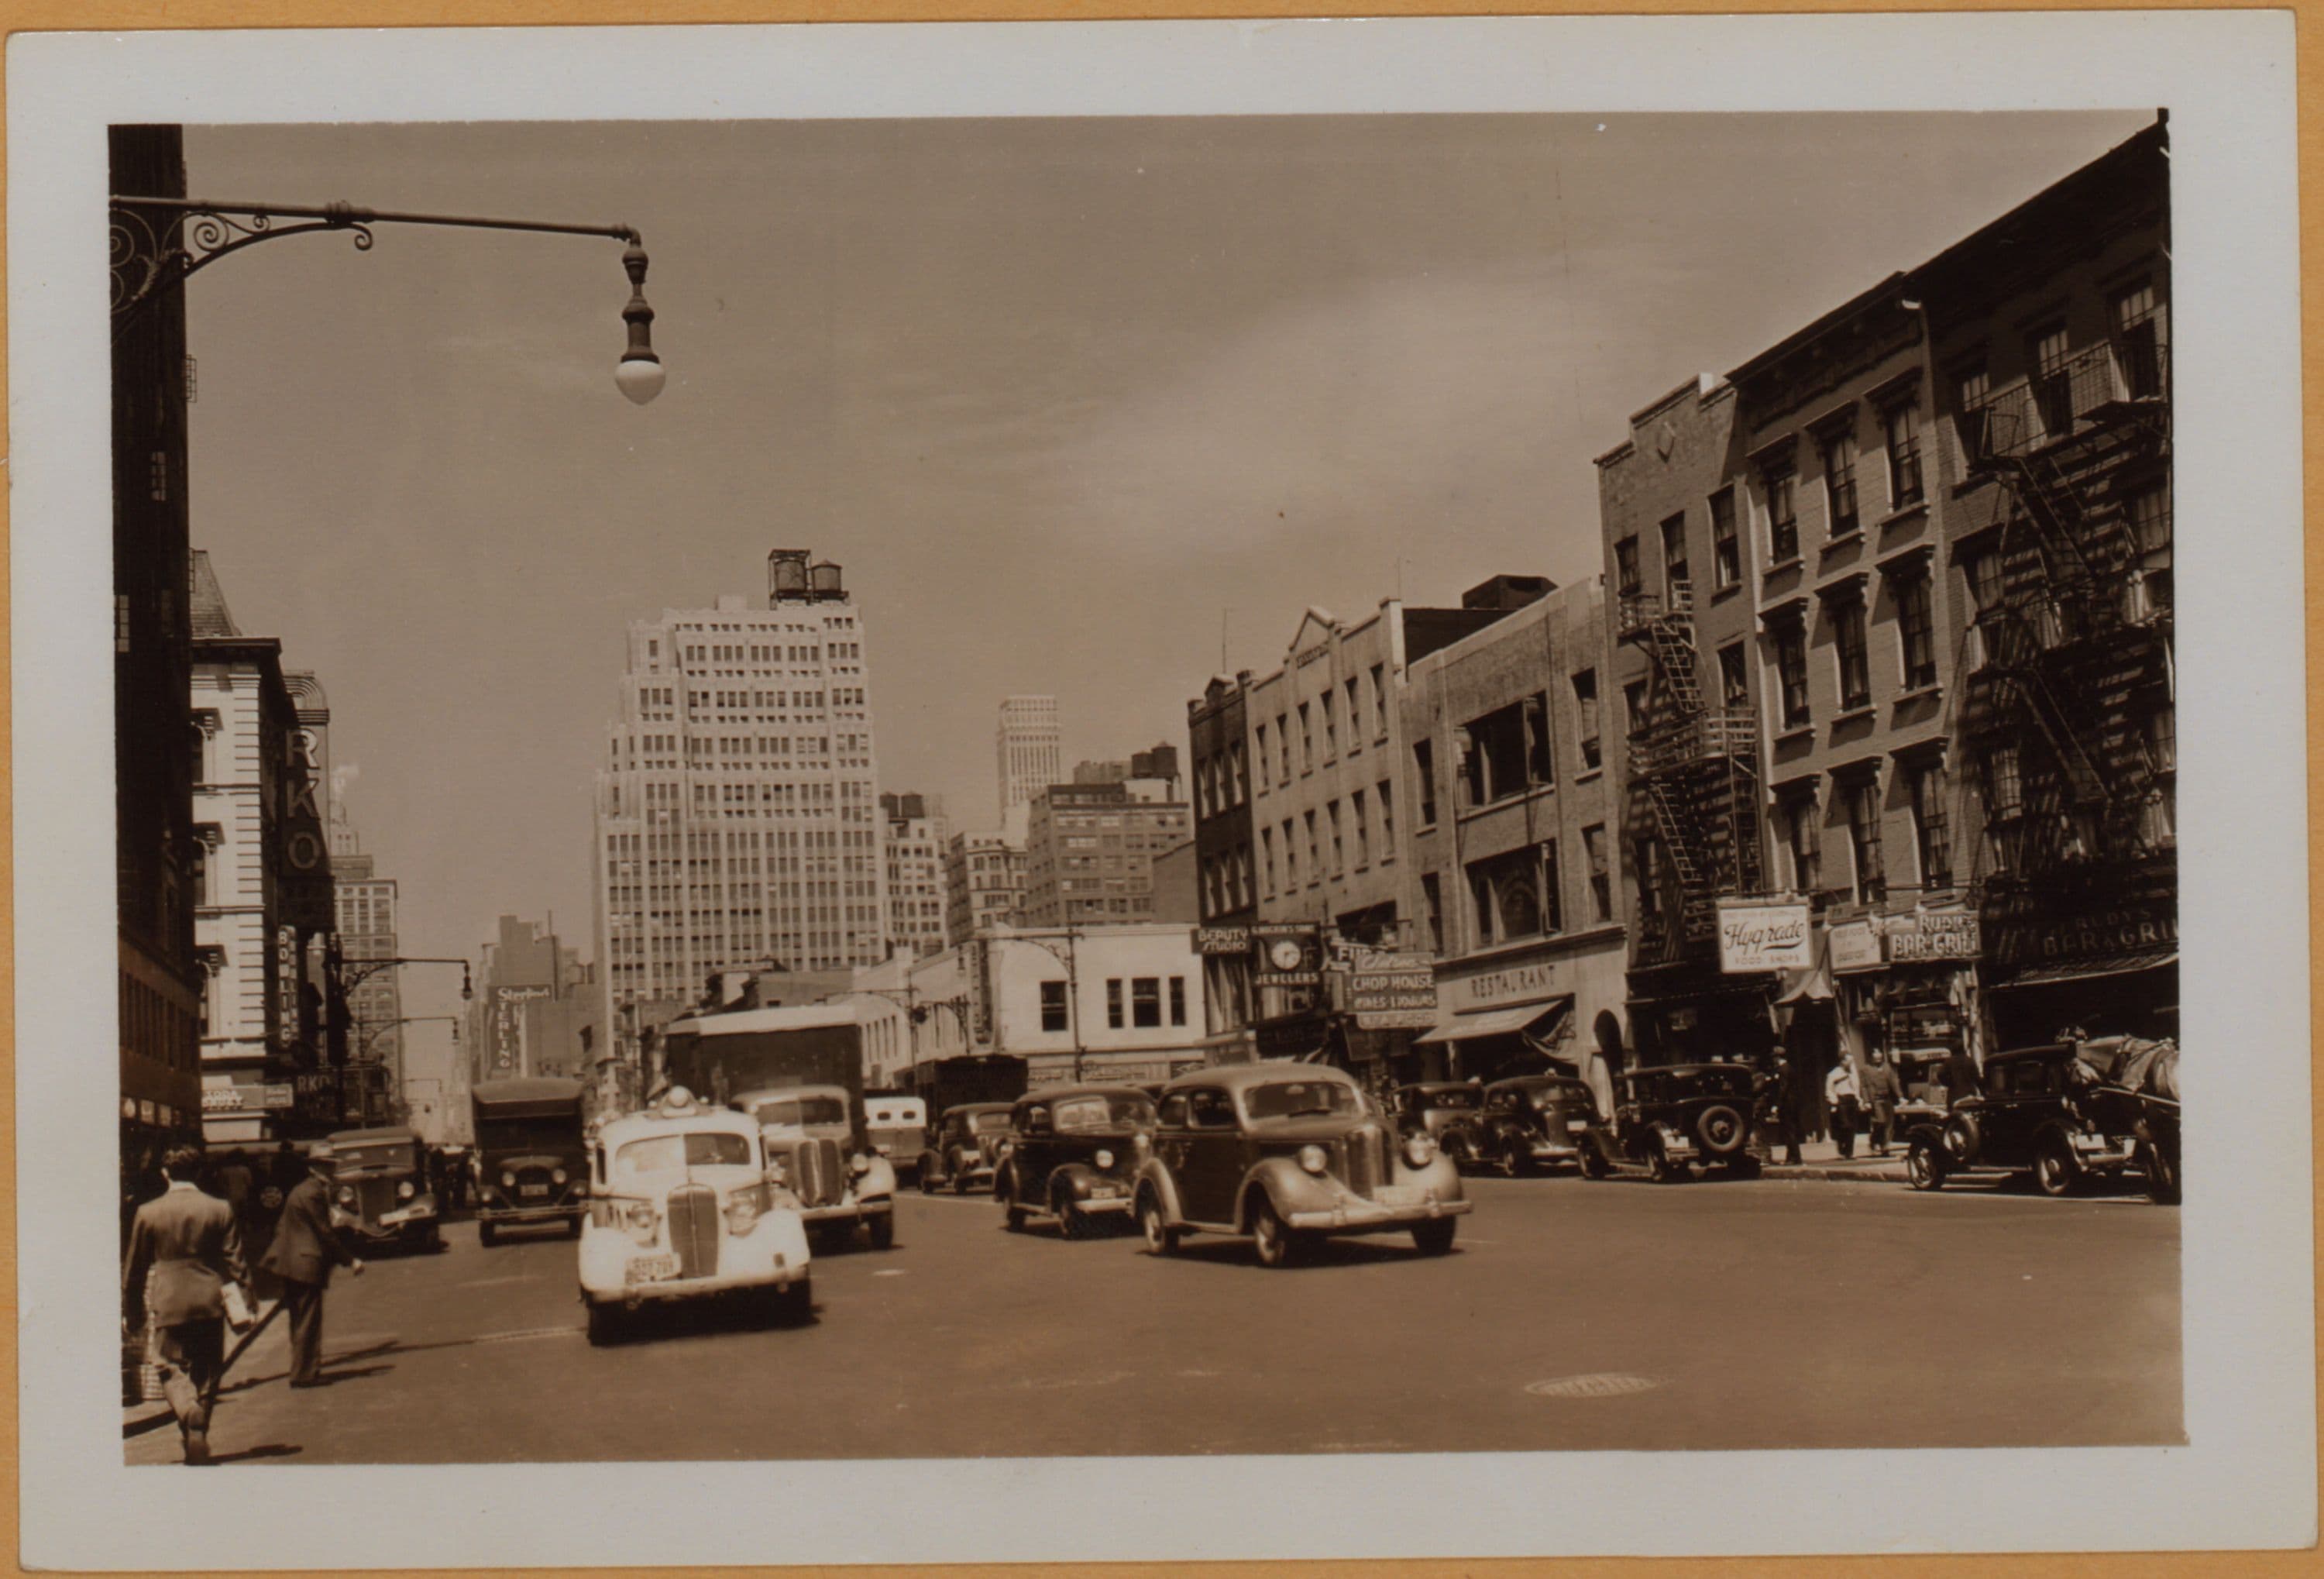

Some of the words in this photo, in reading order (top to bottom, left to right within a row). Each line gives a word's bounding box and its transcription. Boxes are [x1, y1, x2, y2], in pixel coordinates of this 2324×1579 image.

[286, 728, 321, 869] RKO
[1202, 941, 1246, 952] STUDIO
[1724, 920, 1804, 955] Hygrade
[1891, 934, 1927, 958] BAR
[2042, 931, 2098, 956] BAR
[278, 931, 290, 1042] BOWLING
[1352, 975, 1389, 992] CHOP
[1391, 974, 1434, 989] HOUSE
[1470, 964, 1555, 999] RESTAURANT
[297, 1075, 330, 1092] RKO
